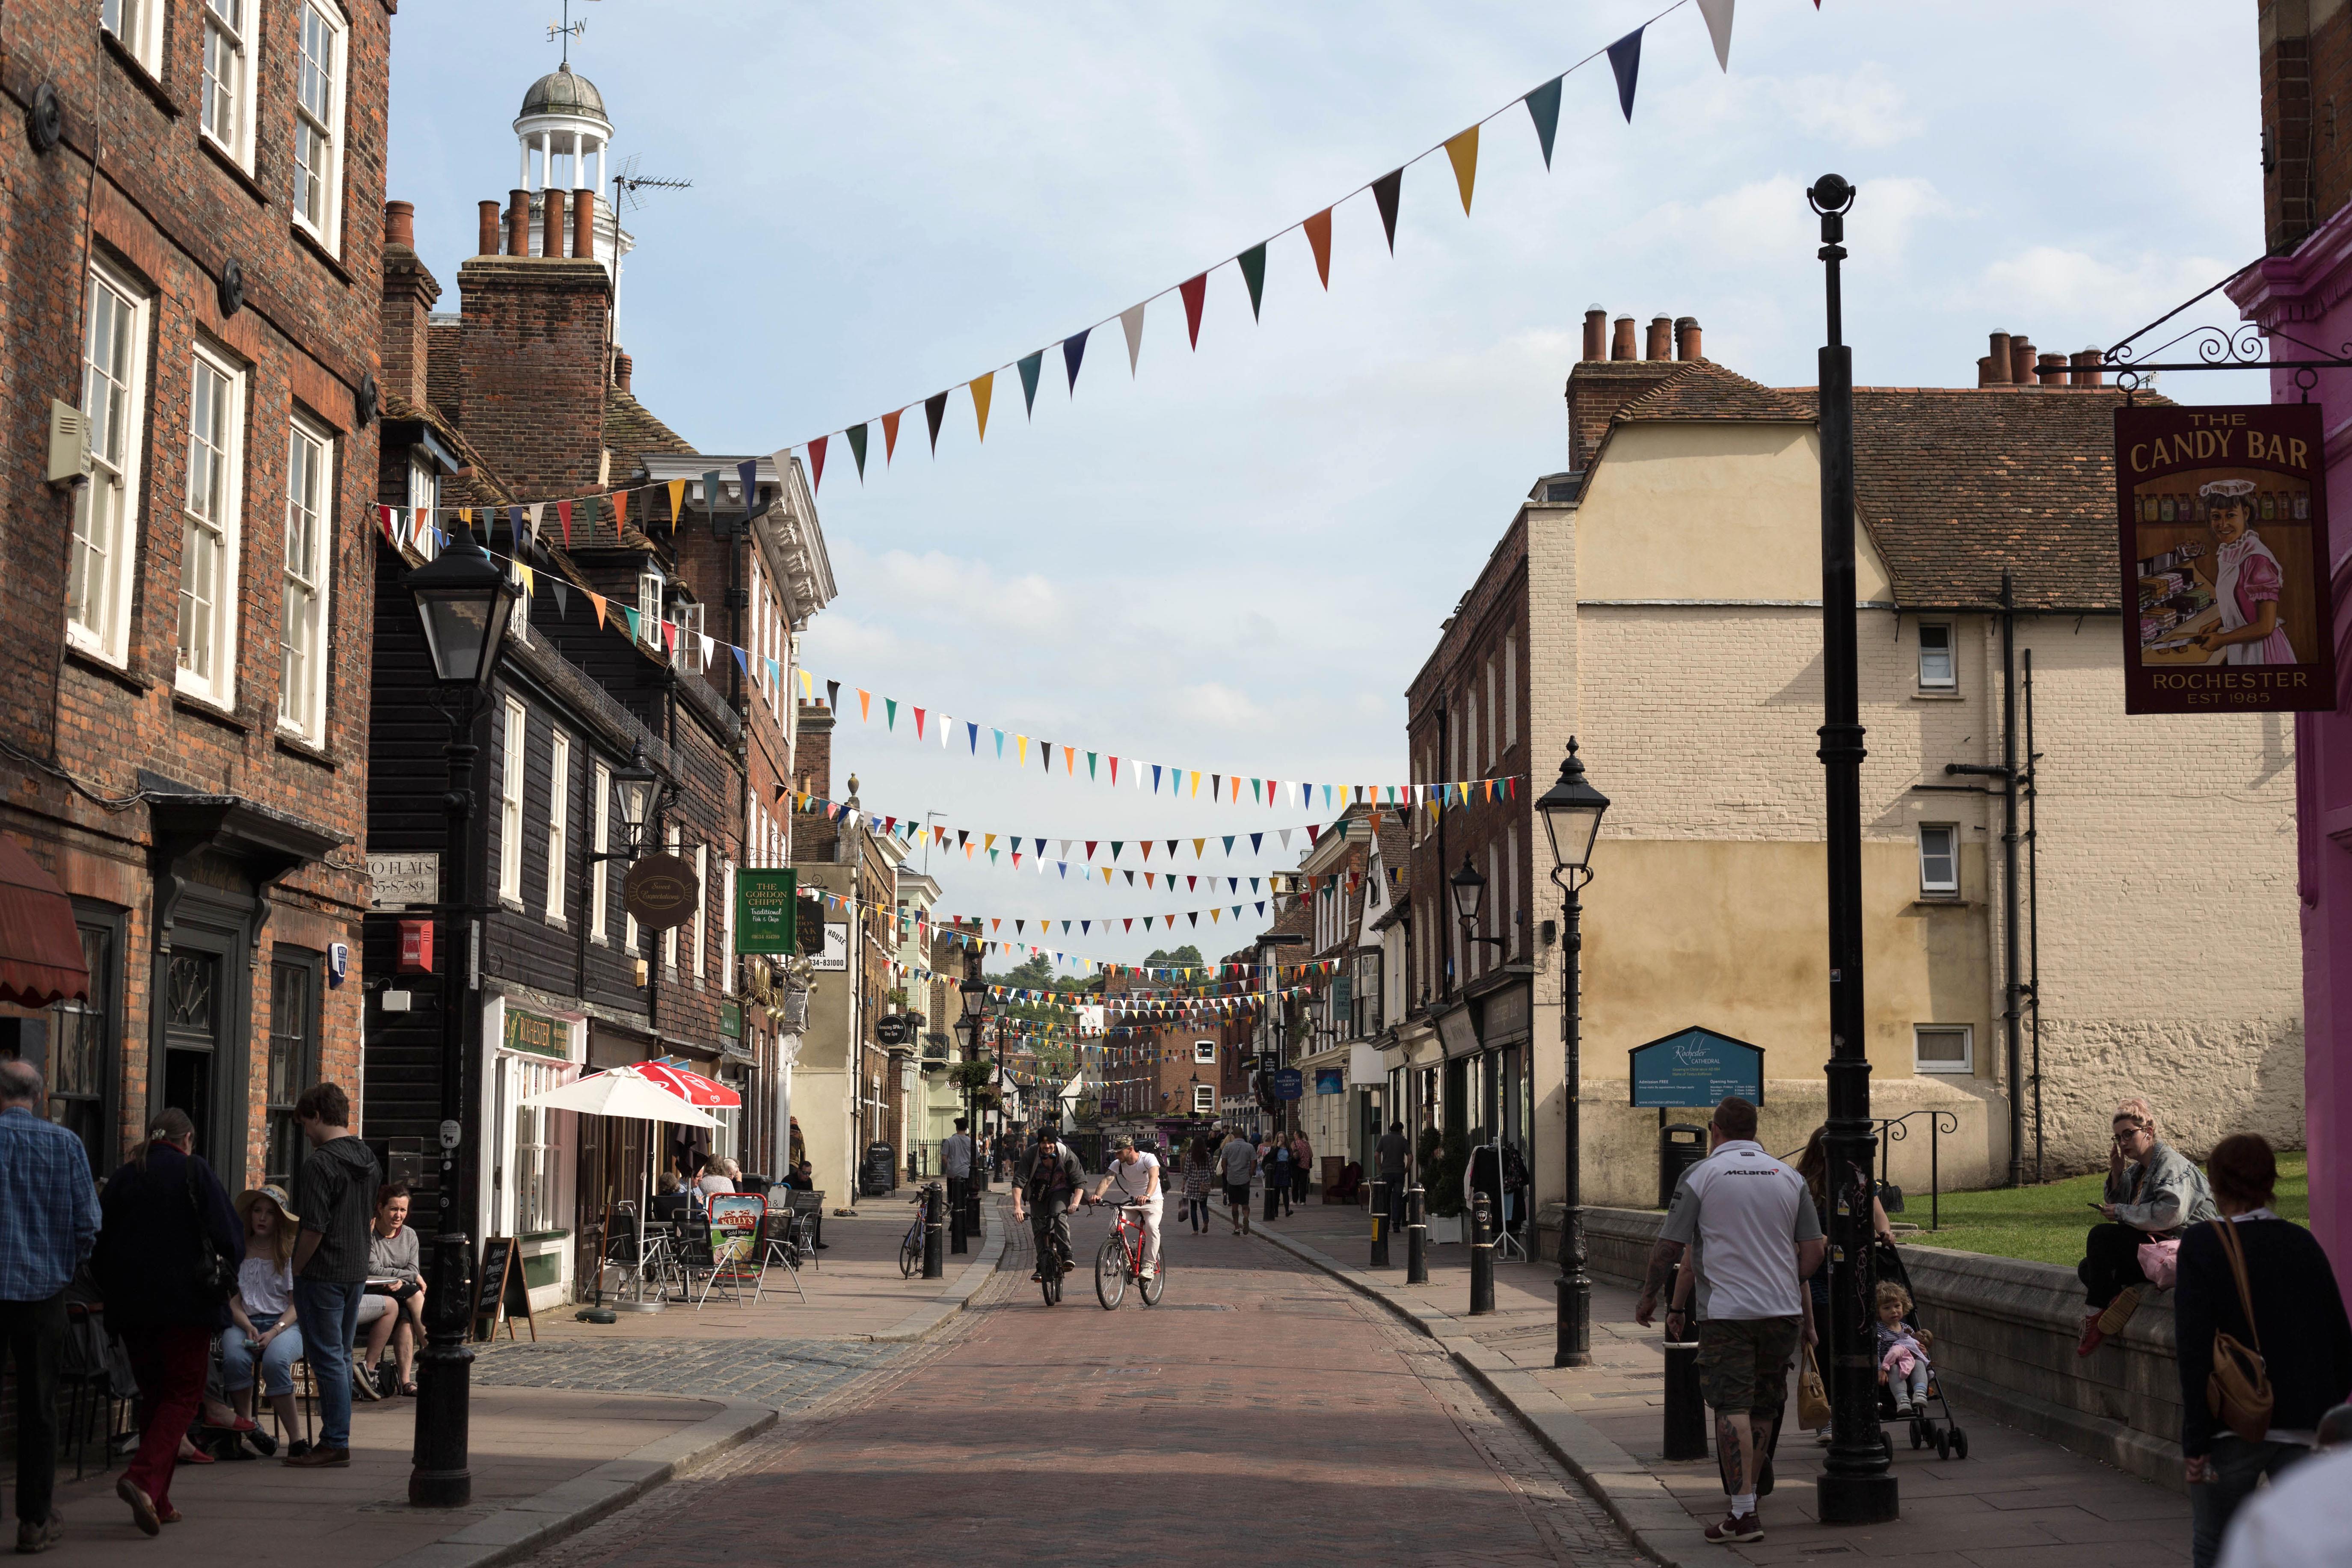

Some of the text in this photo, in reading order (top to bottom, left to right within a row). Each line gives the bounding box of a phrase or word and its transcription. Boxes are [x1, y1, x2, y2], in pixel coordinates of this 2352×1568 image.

[2189, 414, 2247, 426] THE
[2130, 430, 2308, 472] CANDY BAR
[2153, 672, 2308, 689] ROCHESTER
[2188, 693, 2270, 704] EST 1985
[390, 862, 433, 874] FLATS
[641, 890, 679, 900] Expectations
[828, 929, 846, 946] HOUSE
[520, 1017, 549, 1046] ROCHESTER
[1673, 1035, 1710, 1065] Rochester
